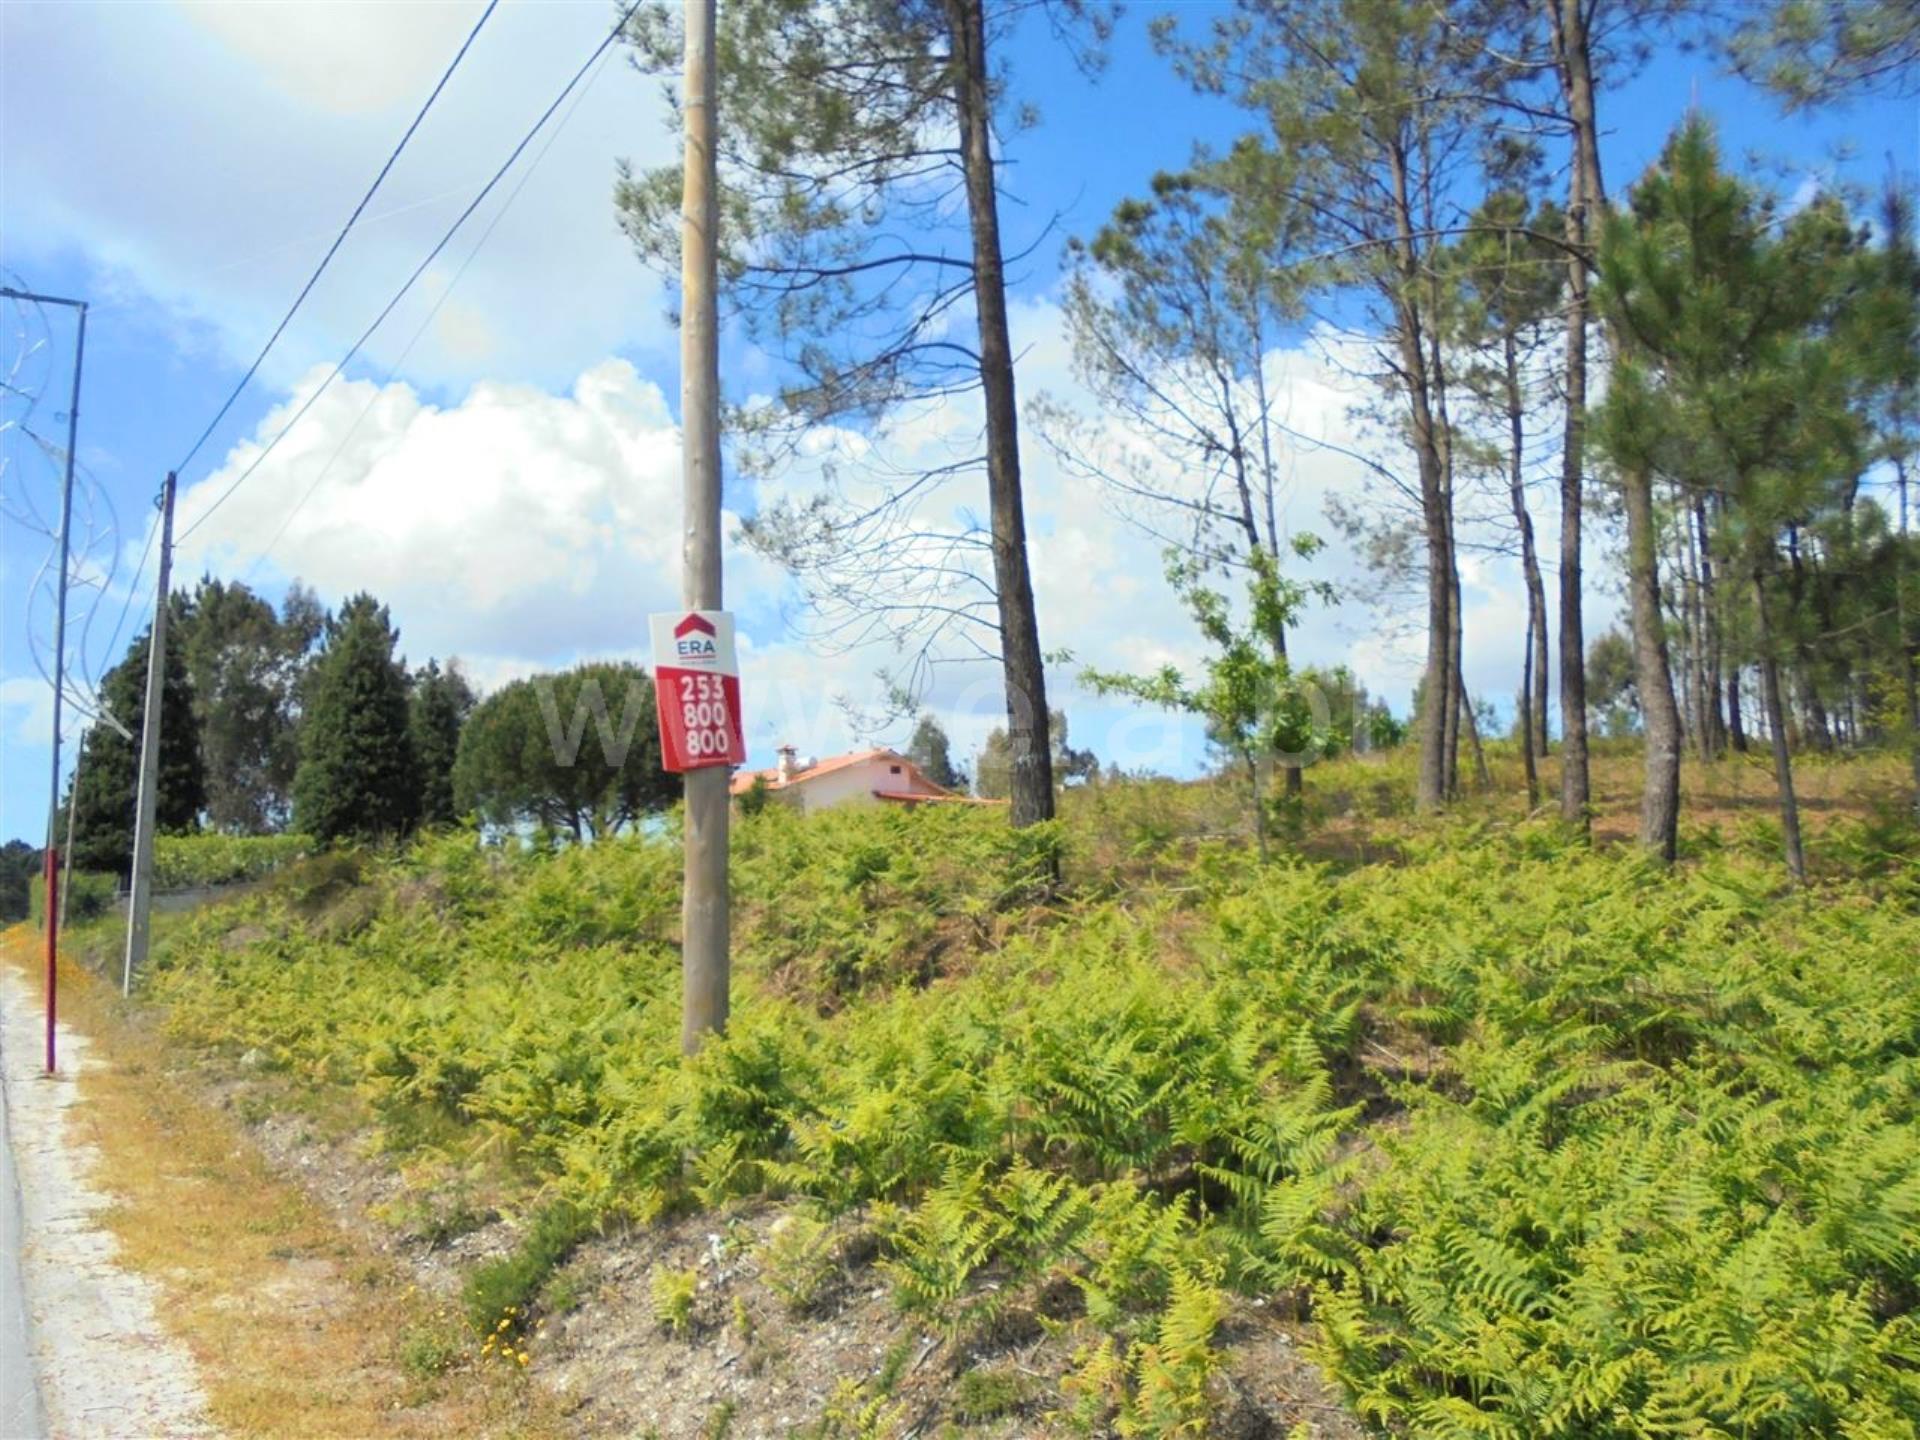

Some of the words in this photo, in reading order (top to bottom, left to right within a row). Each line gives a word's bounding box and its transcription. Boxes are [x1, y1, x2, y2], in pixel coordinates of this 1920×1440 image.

[677, 640, 716, 655] ERA
[680, 675, 725, 702] 253
[683, 702, 727, 729] 800
[686, 728, 729, 756] 800
